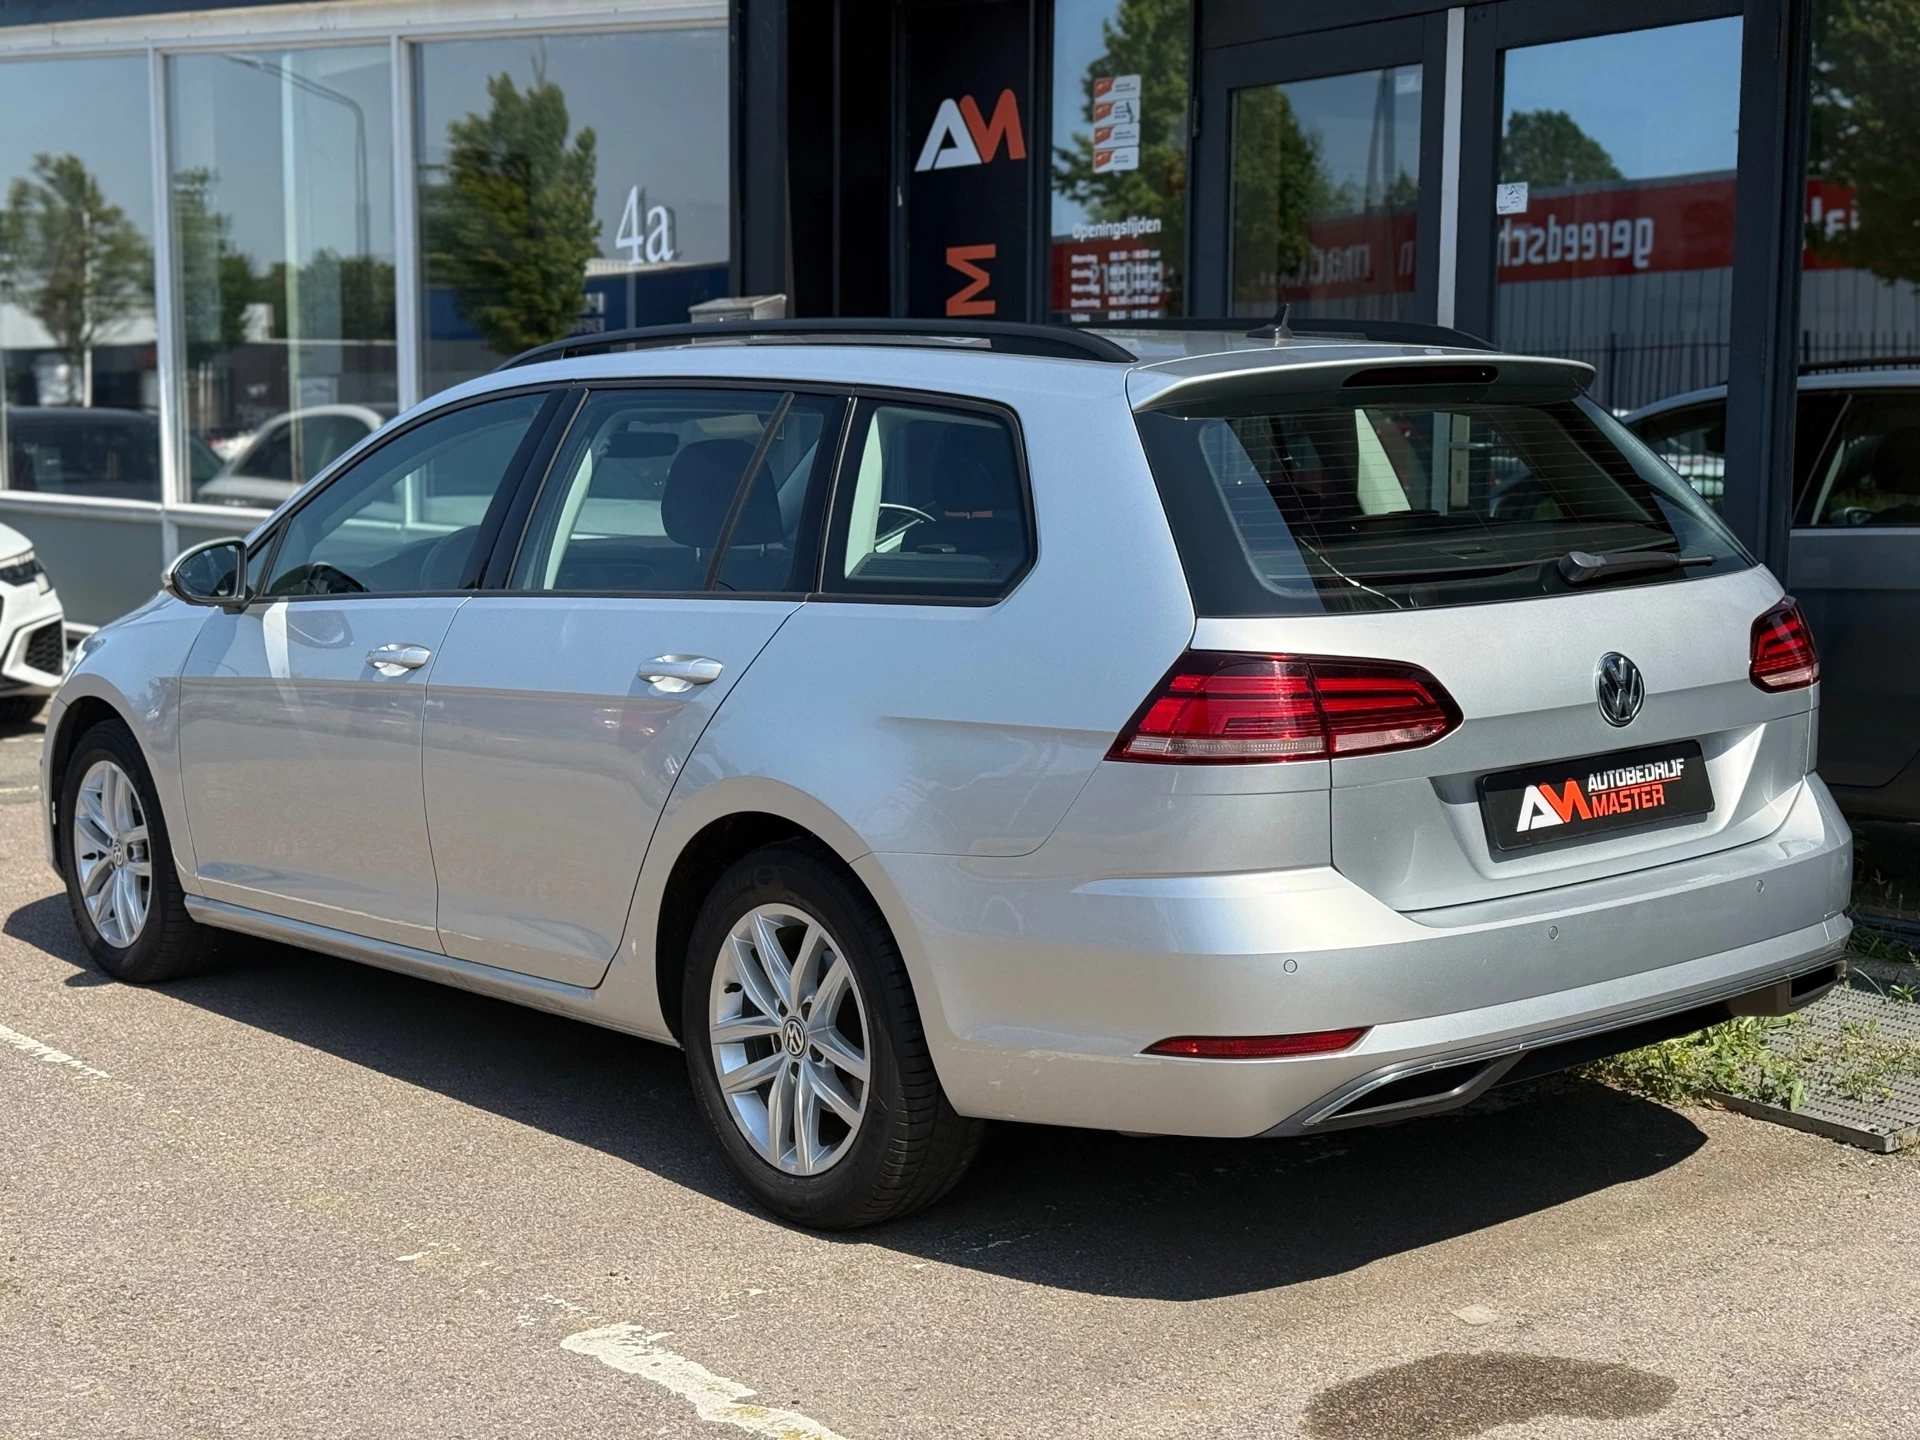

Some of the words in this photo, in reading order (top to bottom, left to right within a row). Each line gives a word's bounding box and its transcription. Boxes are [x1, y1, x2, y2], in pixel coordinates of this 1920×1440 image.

[914, 88, 1026, 172] AM
[615, 185, 674, 264] 4a
[1588, 758, 1685, 792] AUTOBEDRIJF
[1591, 783, 1666, 818] MASTER
[1516, 777, 1593, 832] AM
